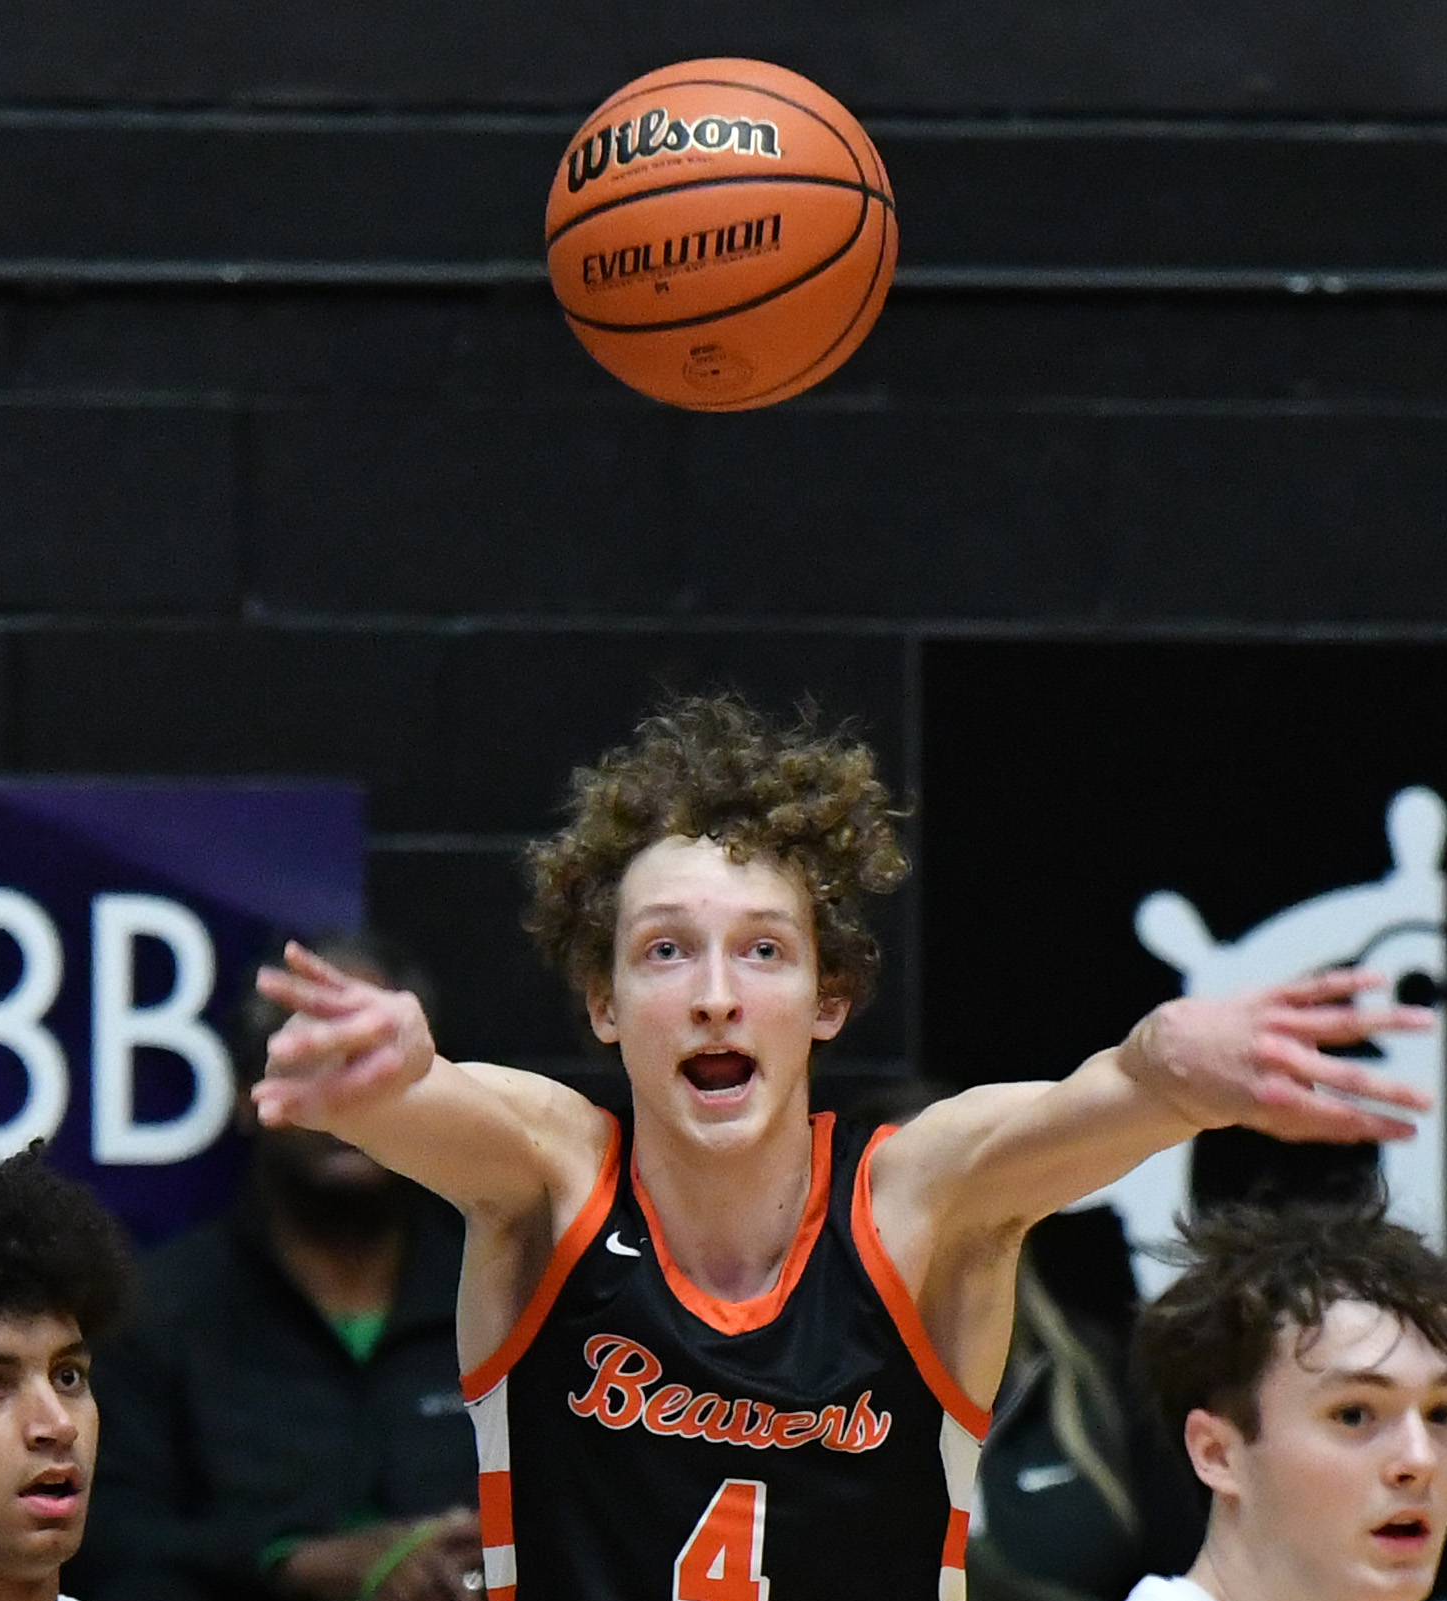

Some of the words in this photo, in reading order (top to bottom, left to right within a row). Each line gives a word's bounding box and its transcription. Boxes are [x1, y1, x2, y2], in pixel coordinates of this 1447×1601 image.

[568, 107, 782, 192] Wilson
[583, 214, 782, 285] EVOLUTION
[568, 1334, 891, 1453] Beavers
